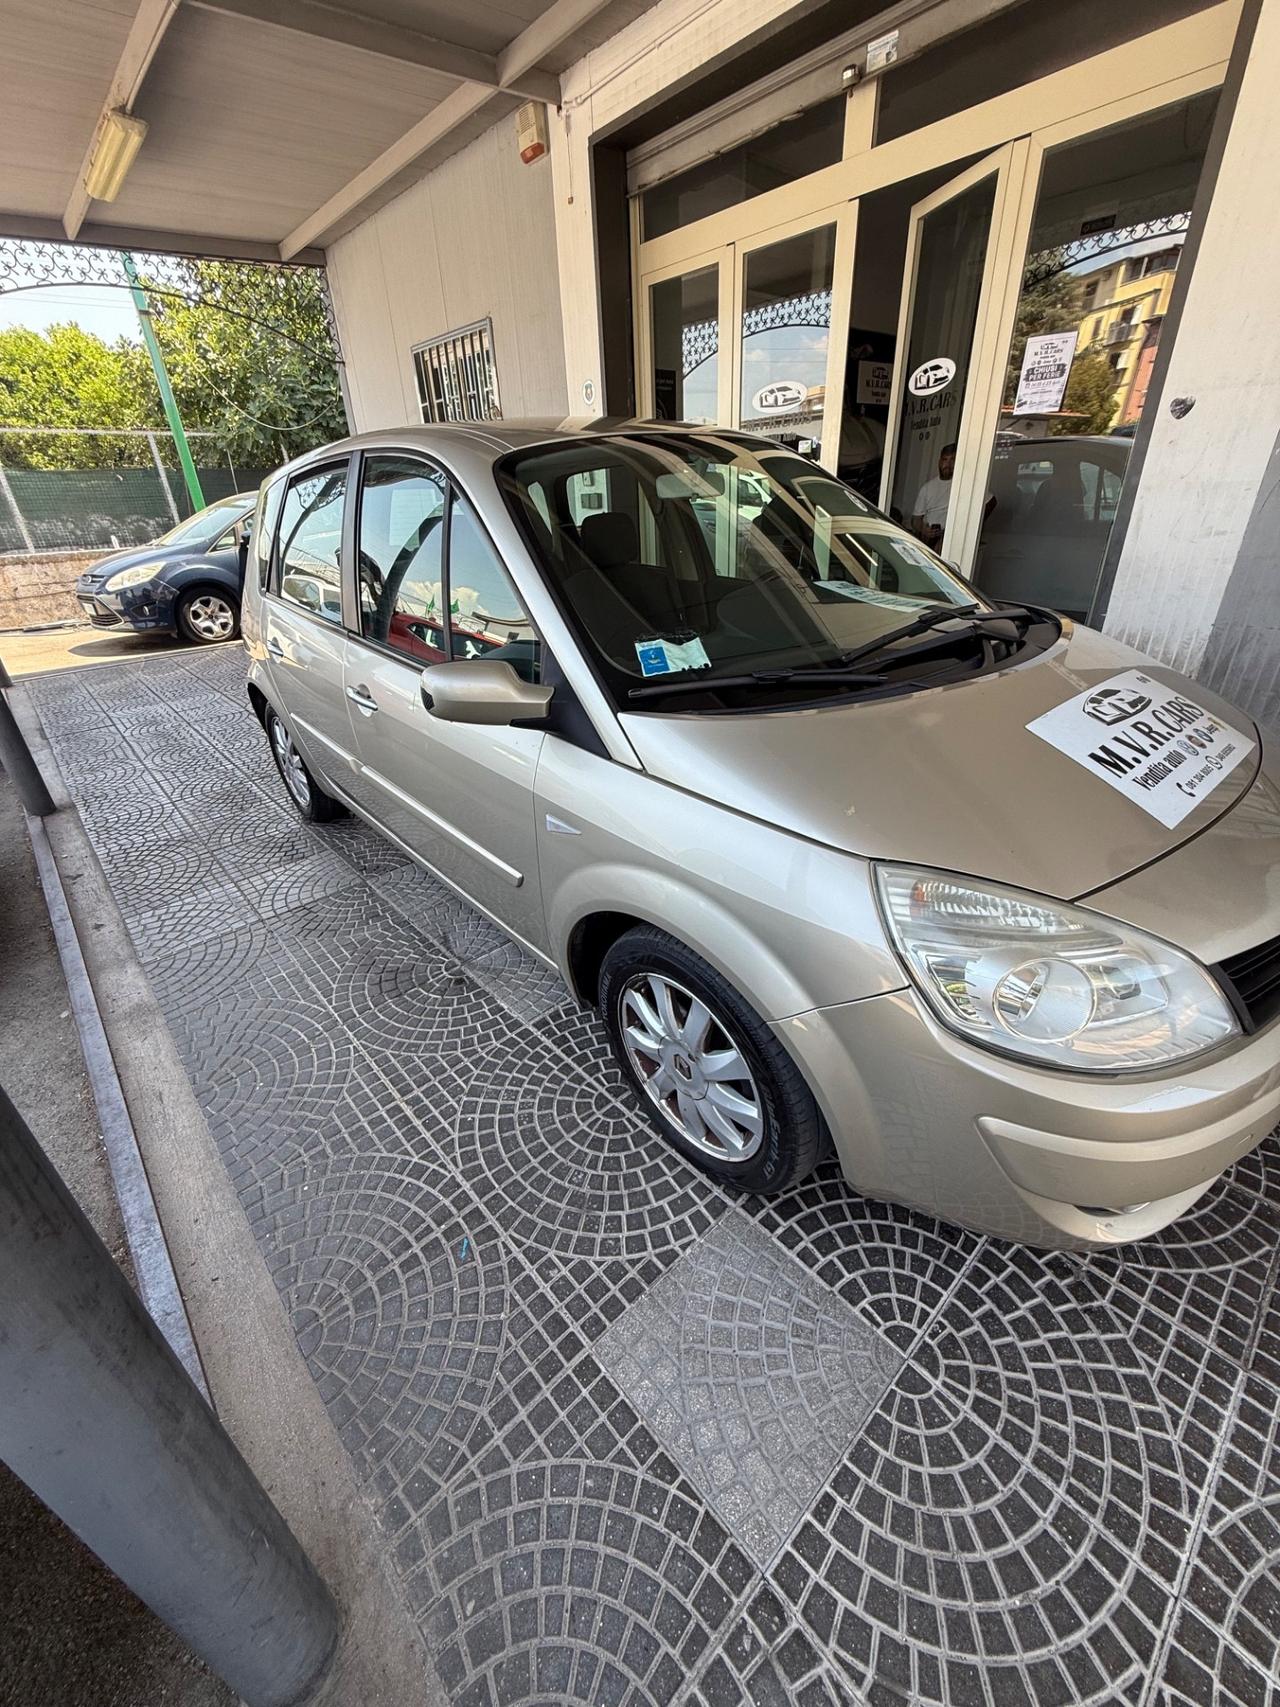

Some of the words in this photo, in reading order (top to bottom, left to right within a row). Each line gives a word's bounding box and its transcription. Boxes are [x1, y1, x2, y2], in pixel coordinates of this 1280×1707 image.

[1029, 373, 1043, 381] PER
[1042, 371, 1061, 380] FERIE
[1033, 365, 1058, 374] CHIUSI
[1088, 696, 1204, 779] M.V.R.CARS
[1132, 761, 1173, 791] Vendita
[1163, 749, 1187, 769] auto
